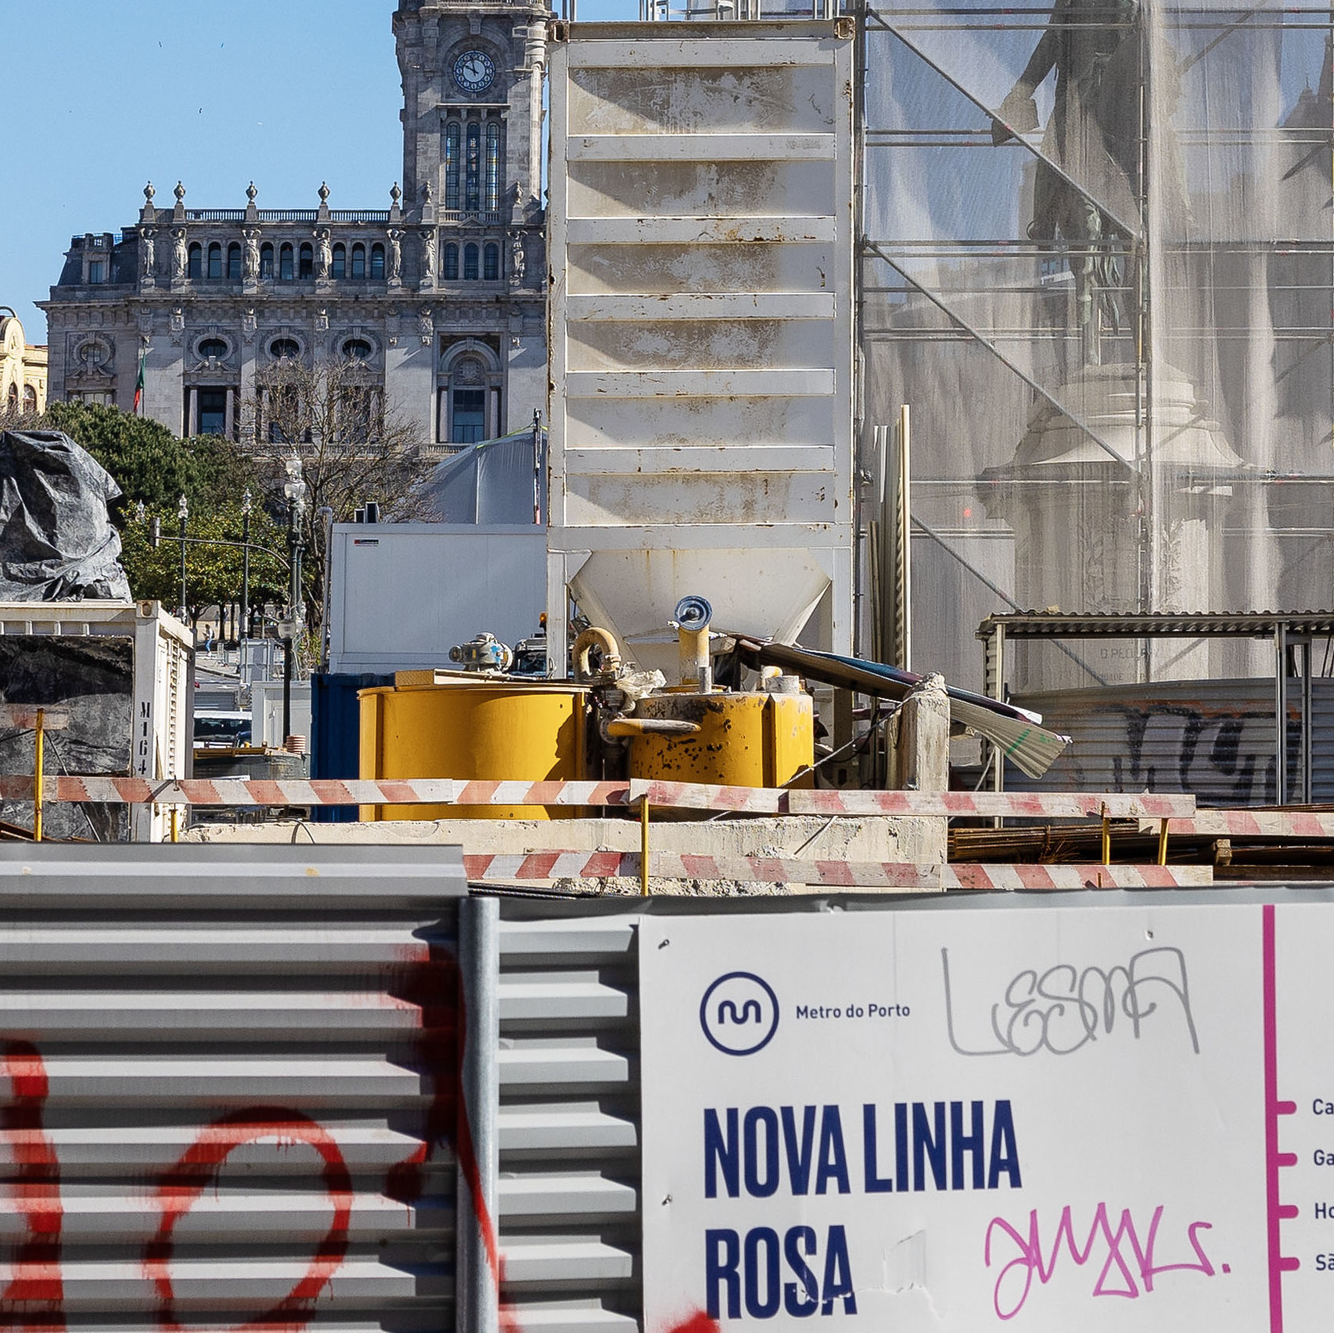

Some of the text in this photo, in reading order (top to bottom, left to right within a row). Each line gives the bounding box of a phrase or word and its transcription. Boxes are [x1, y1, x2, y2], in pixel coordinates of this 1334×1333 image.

[795, 1002, 910, 1019] Metro do Porto
[703, 1098, 1022, 1198] NOVA LINHA
[705, 1222, 858, 1320] ROSA
